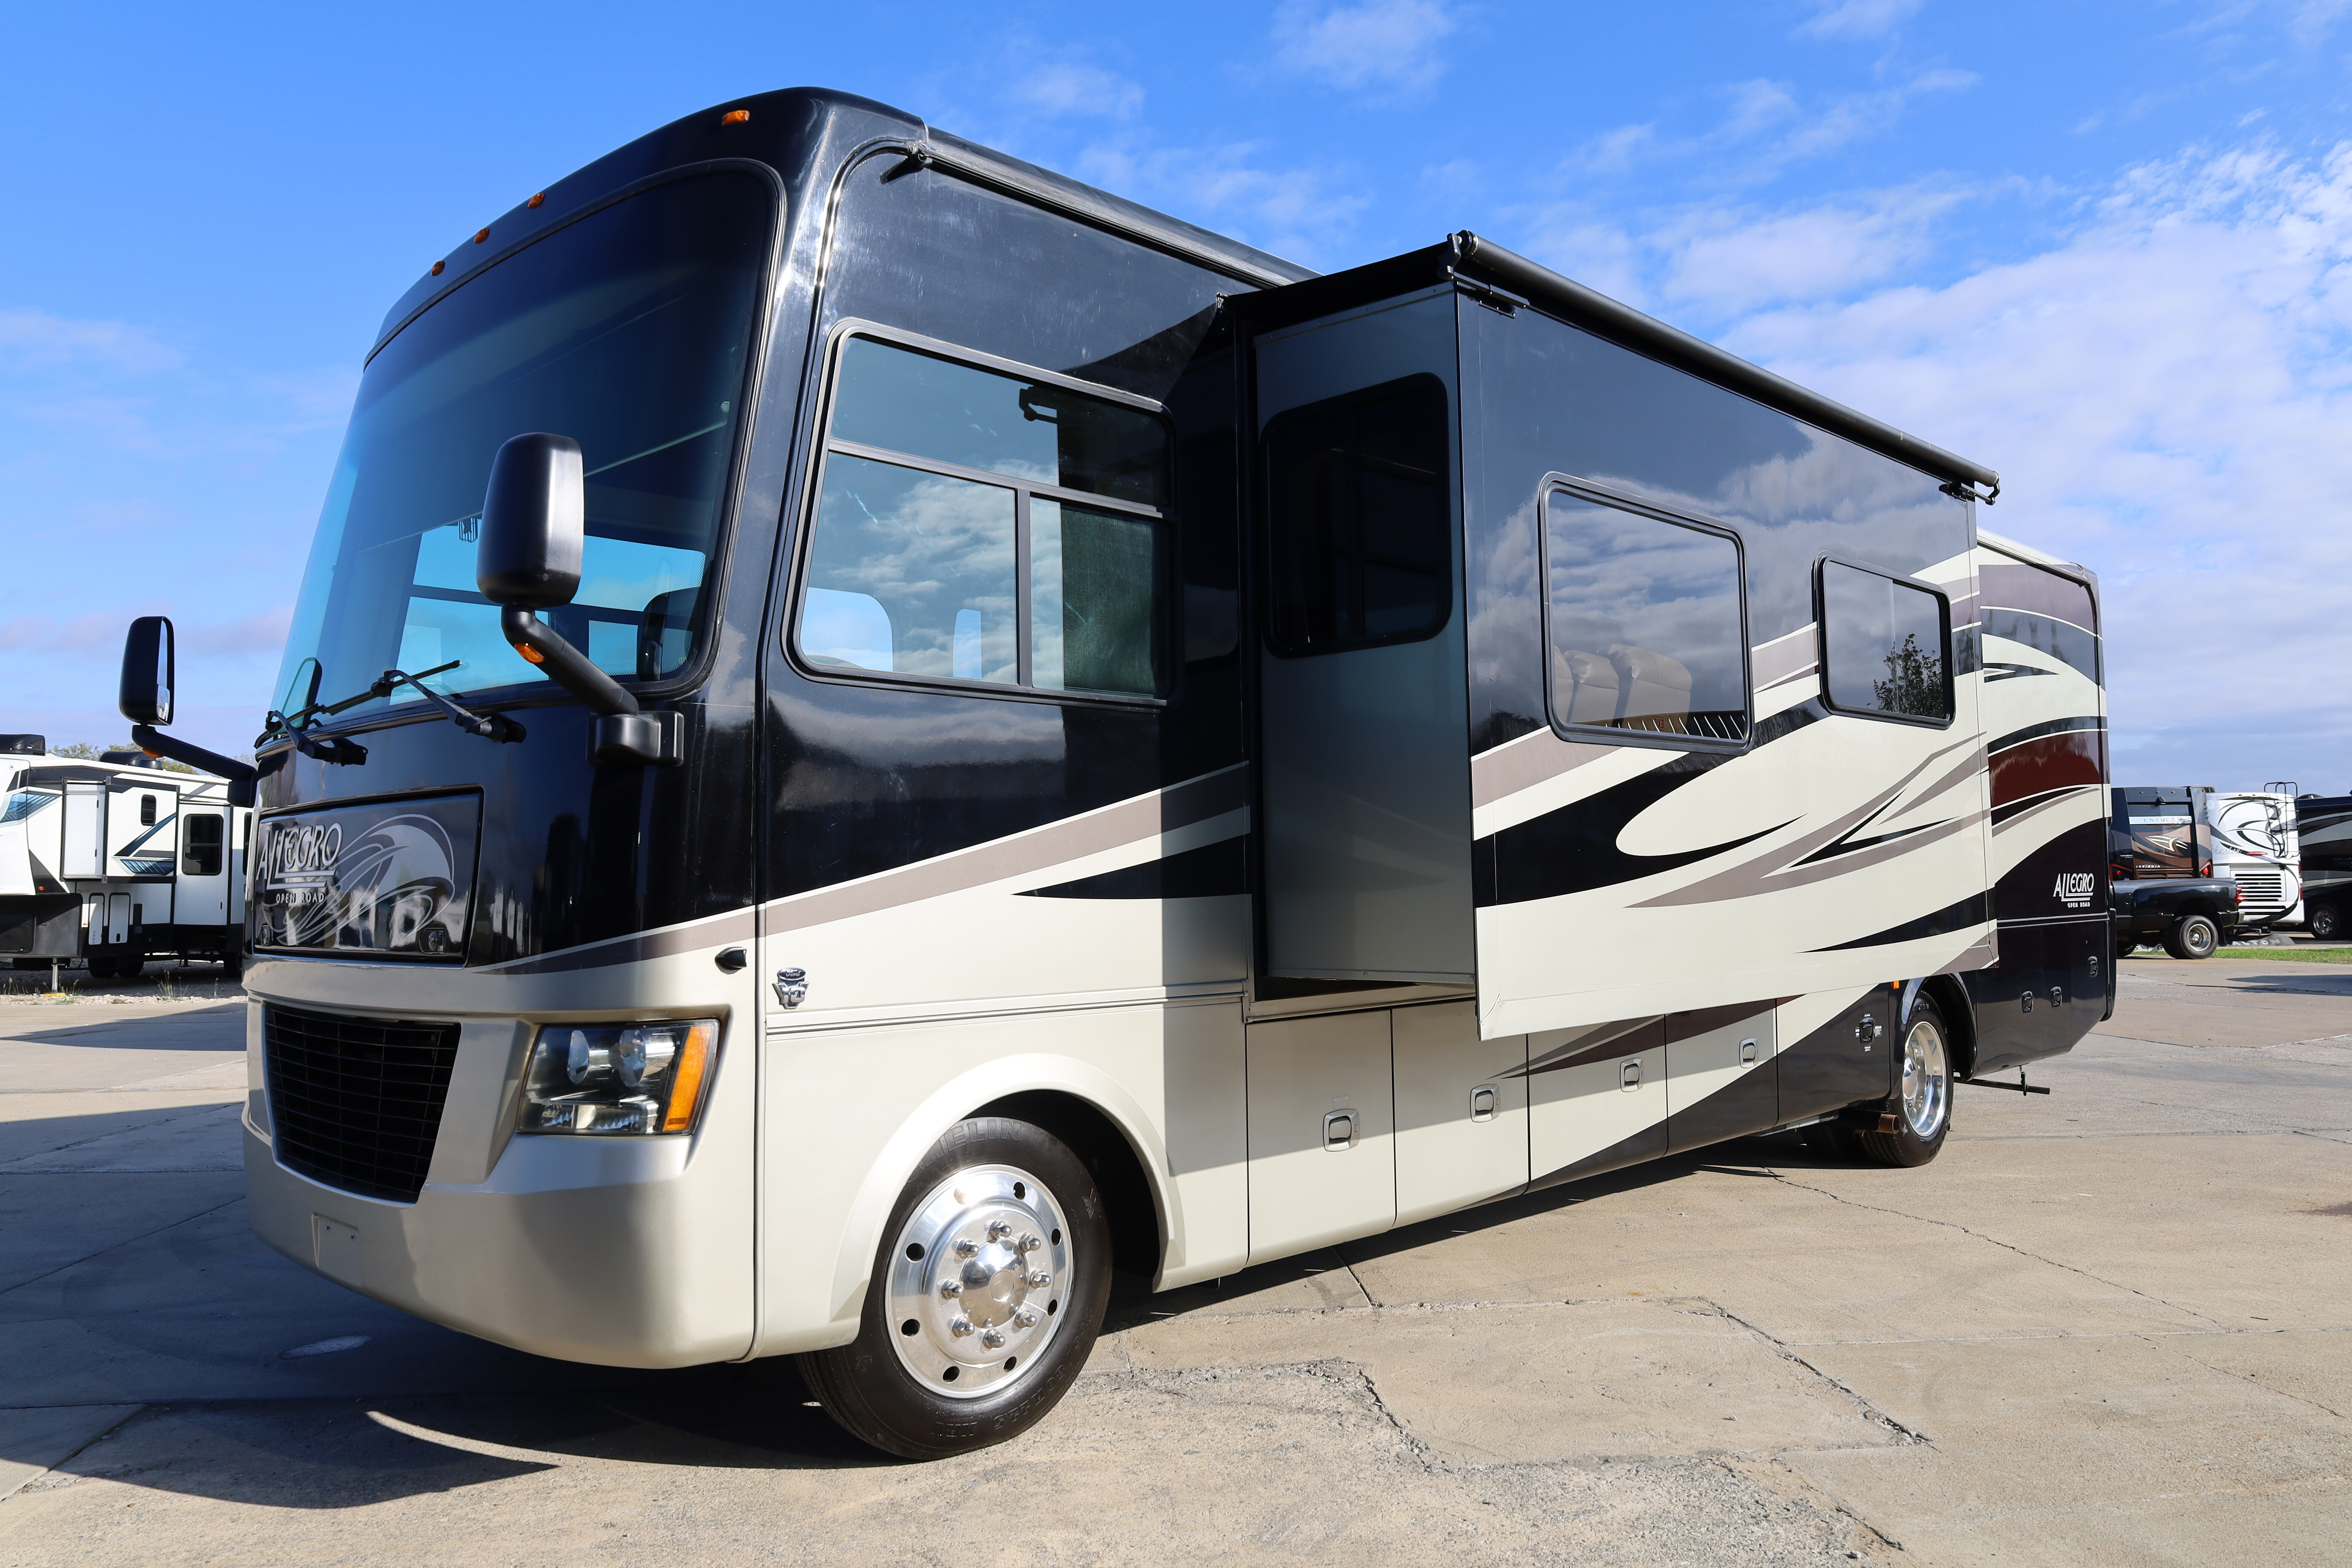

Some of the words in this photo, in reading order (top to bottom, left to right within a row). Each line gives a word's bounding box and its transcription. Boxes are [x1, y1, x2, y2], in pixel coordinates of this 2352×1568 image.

[256, 822, 343, 890] ALLEGRO
[276, 893, 296, 904] OPEN
[302, 892, 325, 903] ROAD
[2053, 873, 2094, 902] ALLEGRO
[772, 982, 810, 1010] V10
